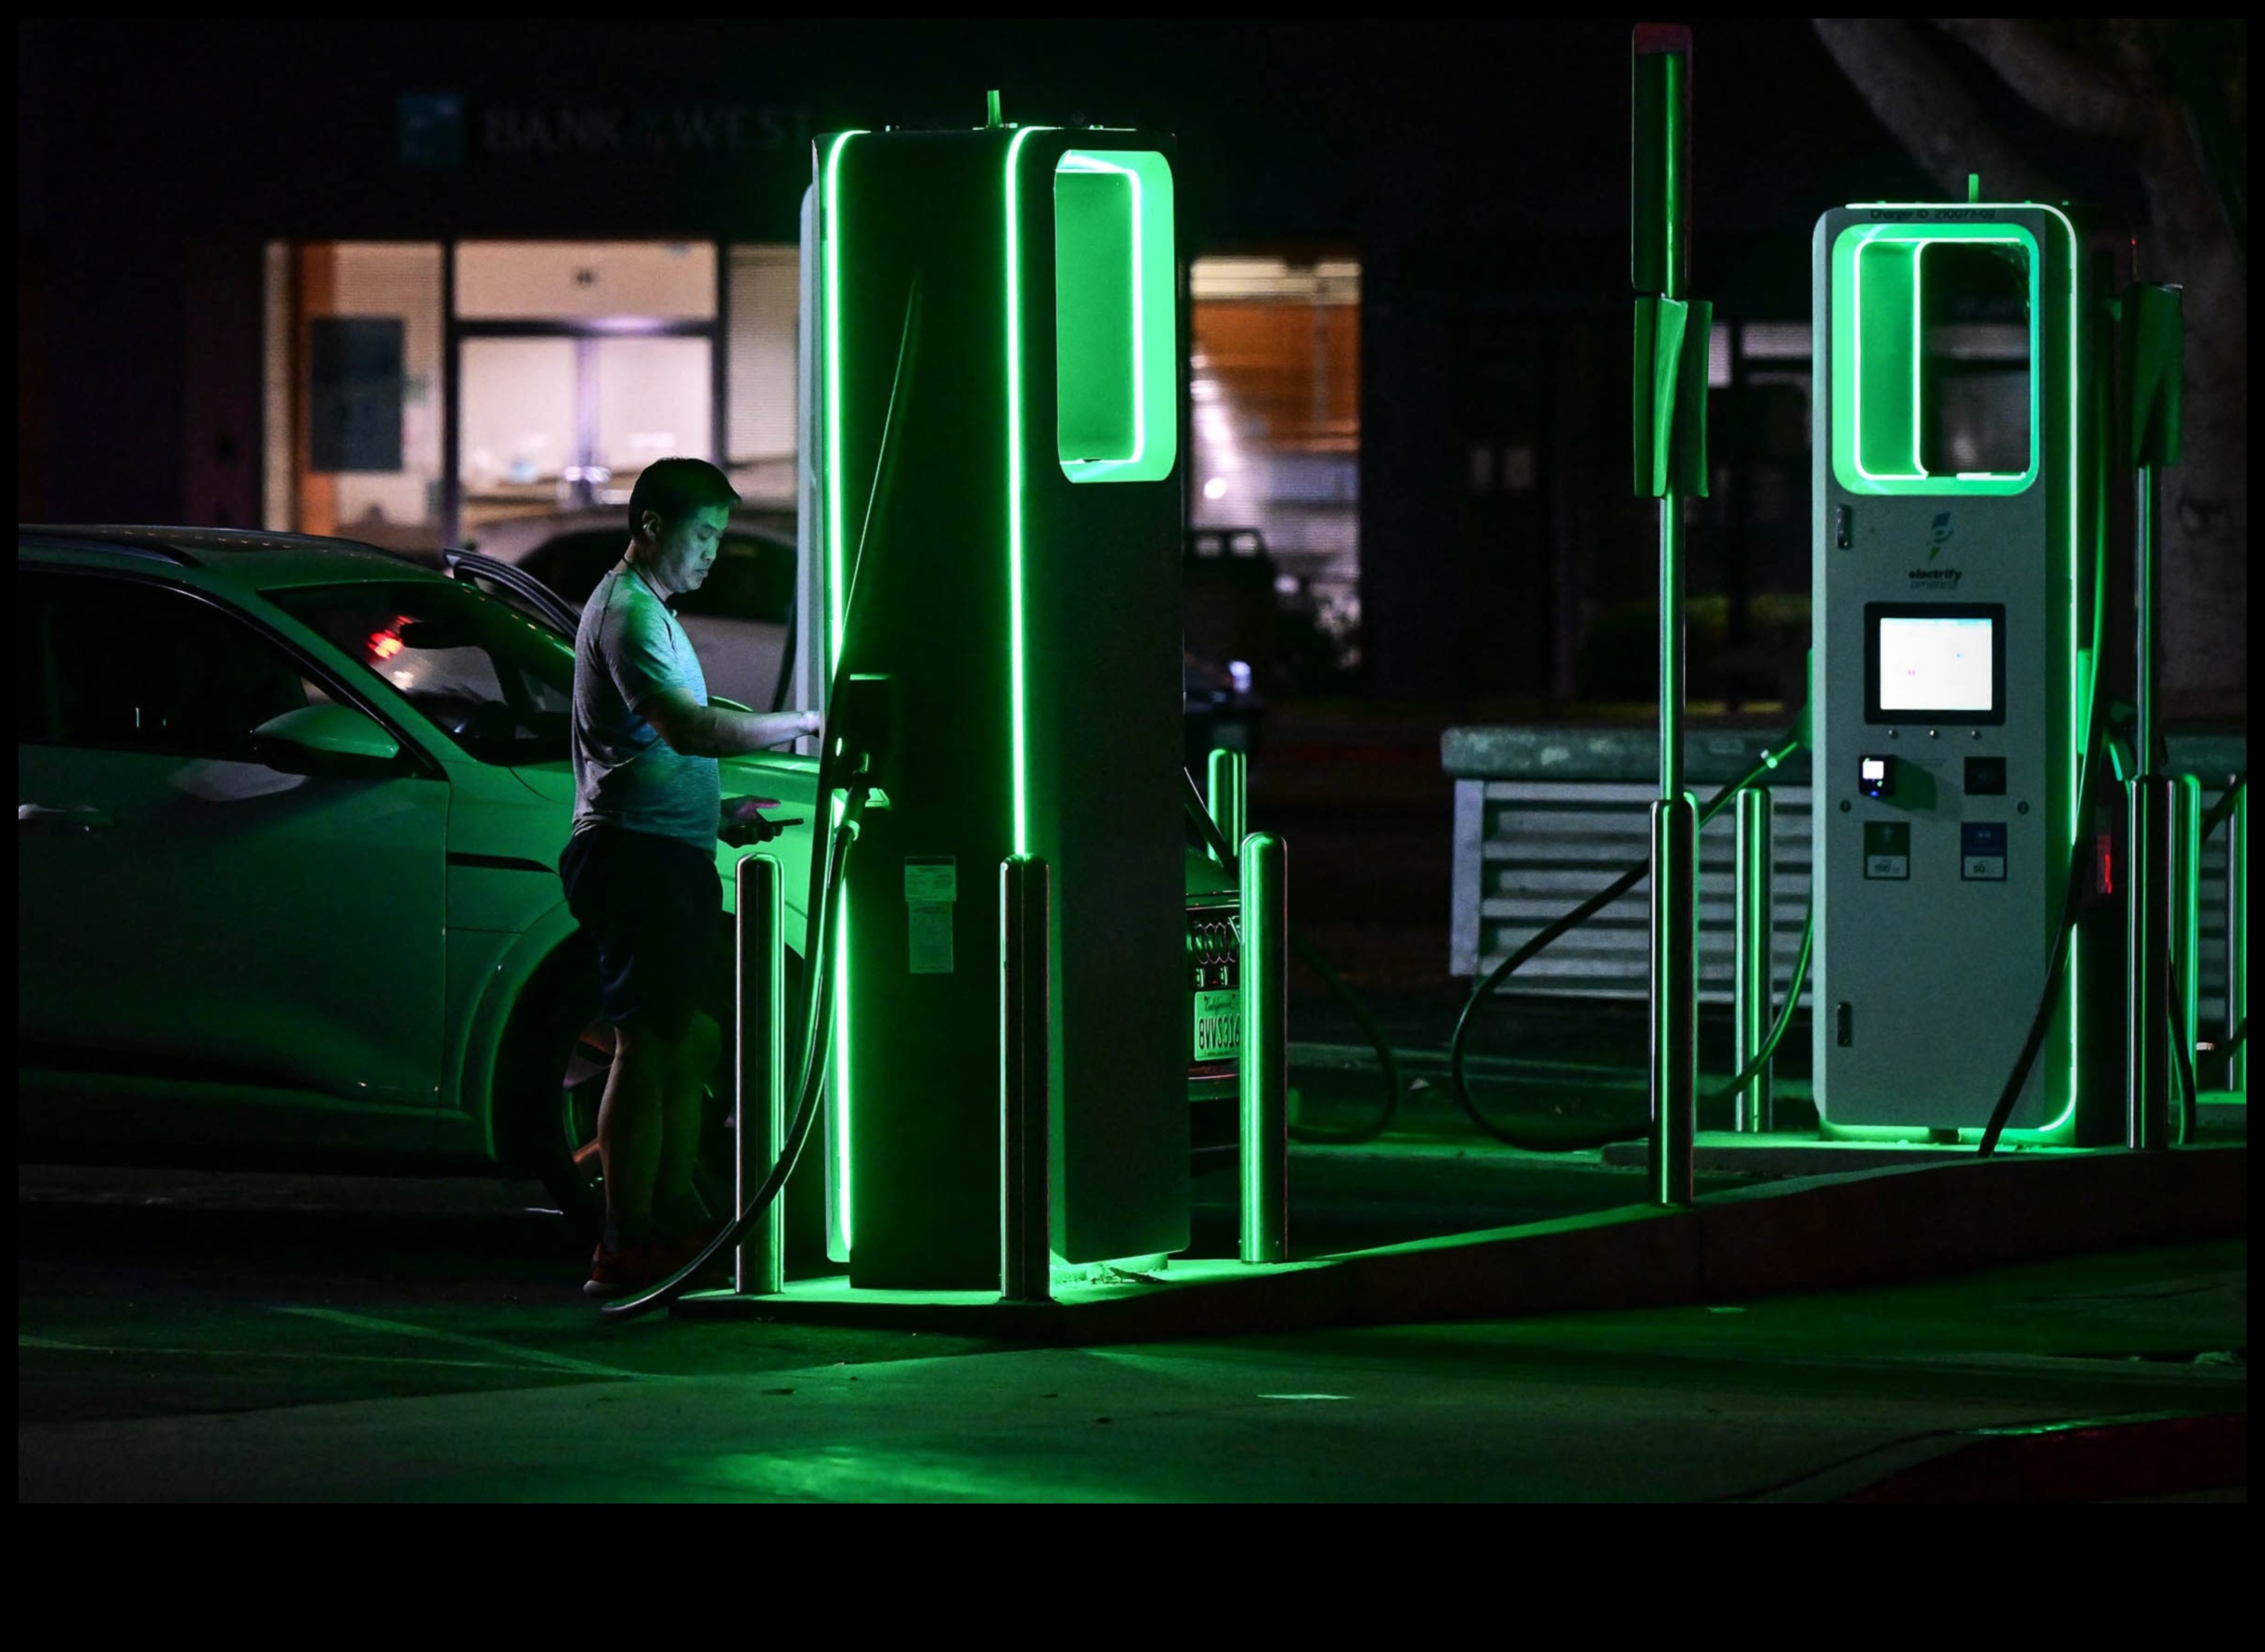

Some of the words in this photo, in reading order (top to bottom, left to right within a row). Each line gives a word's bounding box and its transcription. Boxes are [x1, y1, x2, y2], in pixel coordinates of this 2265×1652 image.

[482, 106, 622, 150] BANK
[1870, 209, 1912, 221] Charger
[1917, 209, 1929, 219] ID
[1909, 568, 1962, 587] electrify
